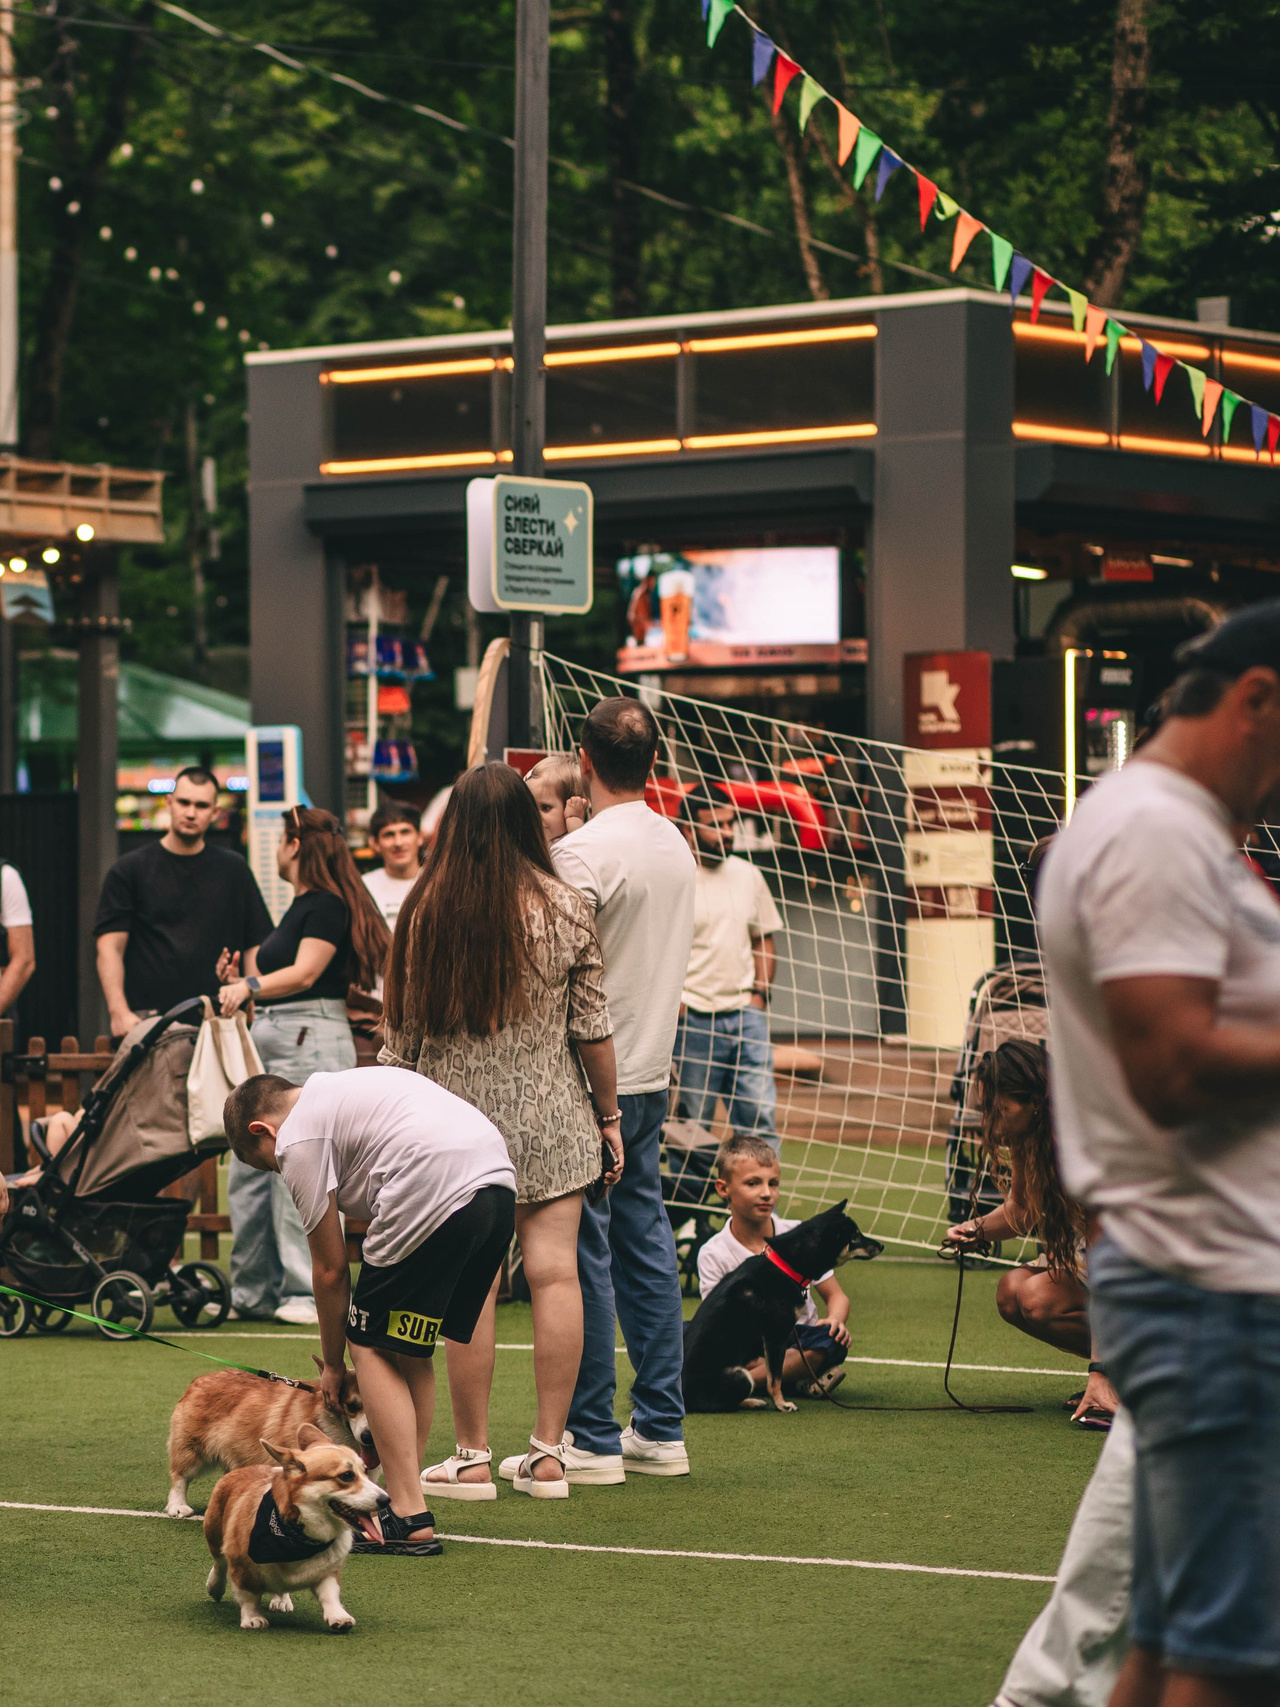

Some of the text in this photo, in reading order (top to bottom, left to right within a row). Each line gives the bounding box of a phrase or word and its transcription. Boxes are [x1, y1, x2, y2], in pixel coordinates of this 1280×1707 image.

[504, 493, 540, 514] СИЯЙ
[504, 516, 556, 536] БЛЕСТИ
[504, 537, 564, 558] СВЕРКАЙ
